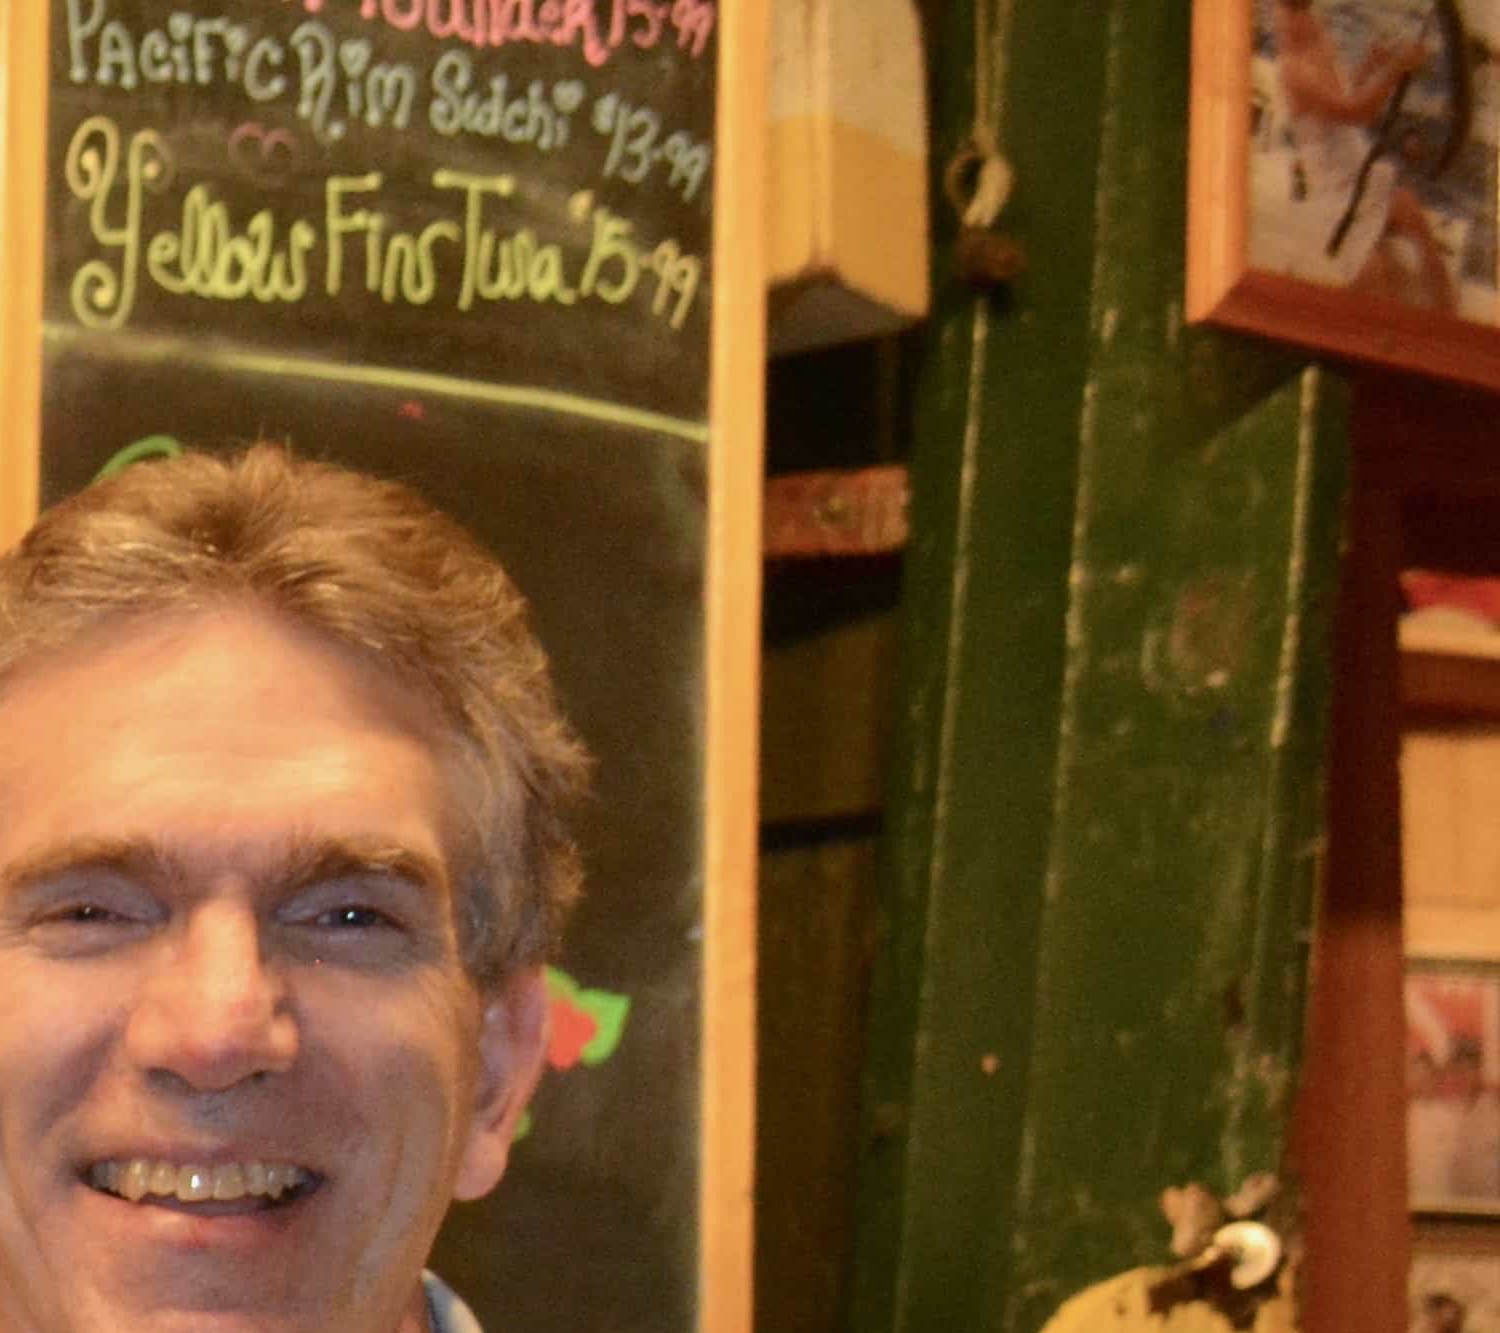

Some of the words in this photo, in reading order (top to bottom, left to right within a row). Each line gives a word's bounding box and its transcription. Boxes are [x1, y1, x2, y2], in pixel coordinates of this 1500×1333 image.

[65, 114, 316, 331] Yellow
[325, 170, 462, 304] Fin
[432, 167, 578, 312] Tuna
